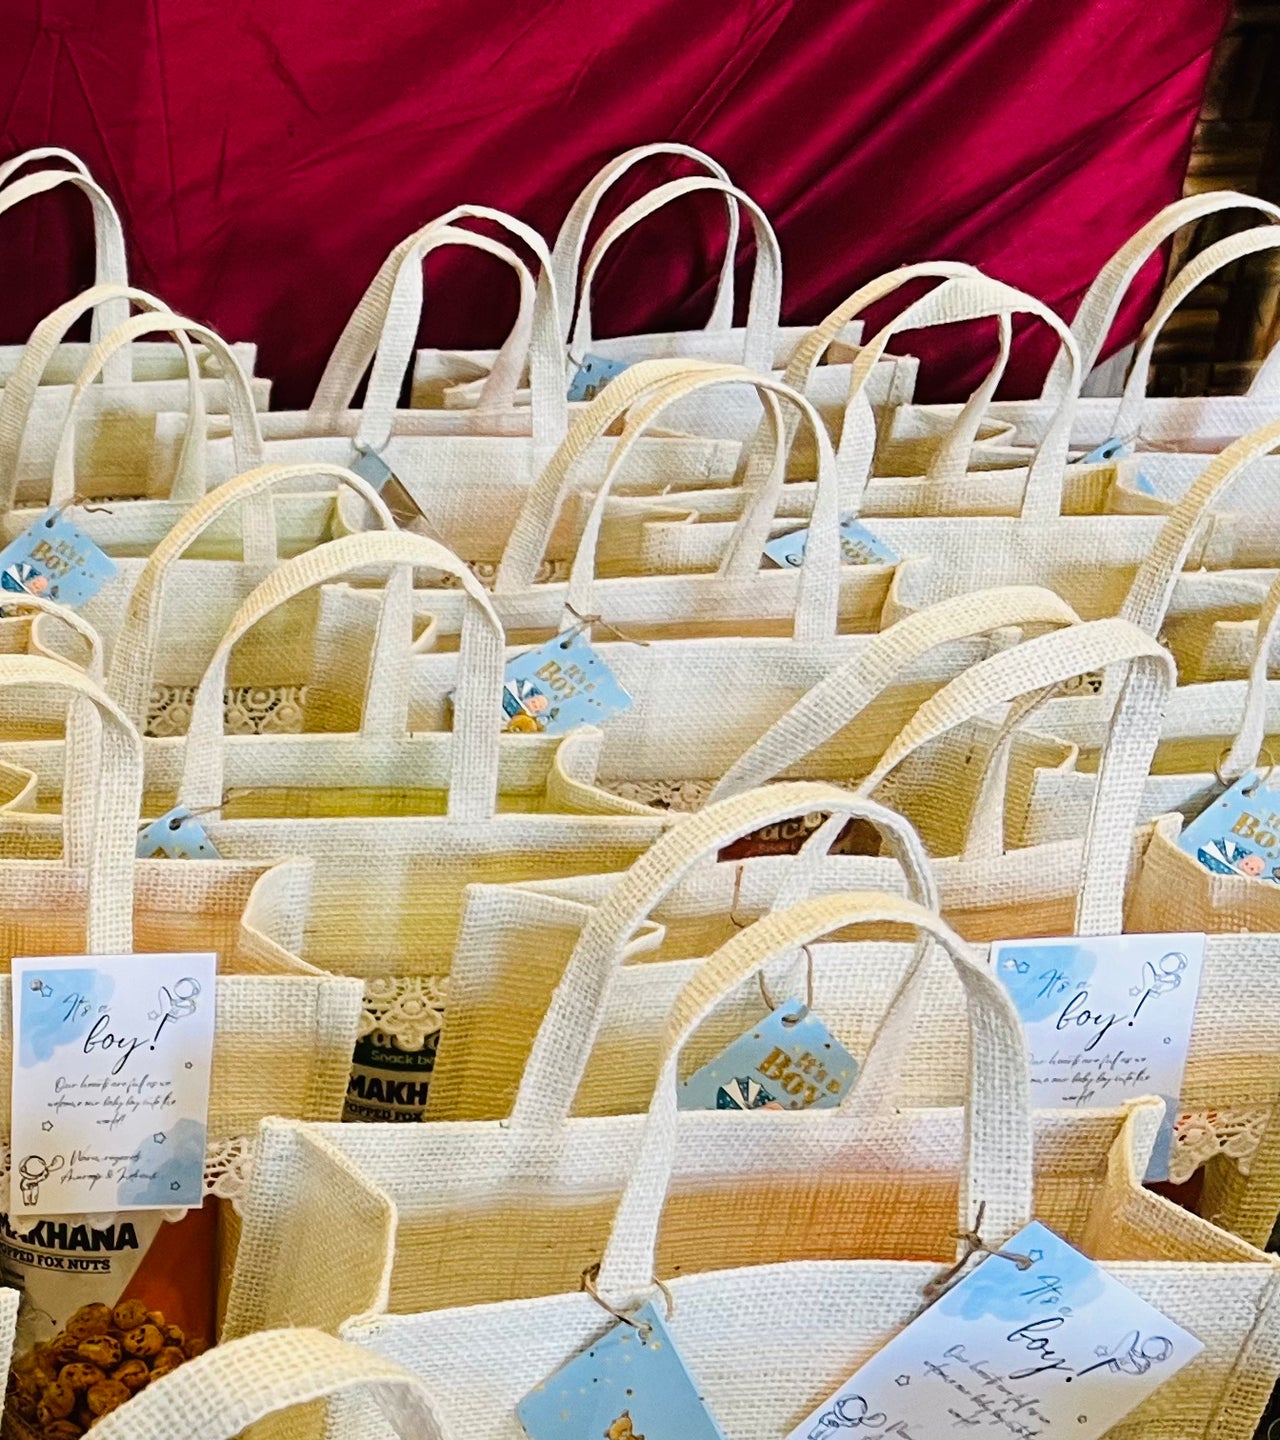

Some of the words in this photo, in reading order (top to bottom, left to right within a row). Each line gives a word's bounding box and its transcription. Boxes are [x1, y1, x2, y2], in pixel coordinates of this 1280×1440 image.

[1230, 811, 1280, 860] Bo
[84, 1014, 168, 1075] boy!
[1056, 988, 1151, 1051] boy!
[755, 1046, 827, 1109] Boy
[37, 1255, 65, 1269] FOX
[68, 1256, 111, 1271] NUTS
[1008, 1317, 1114, 1382] boy!
